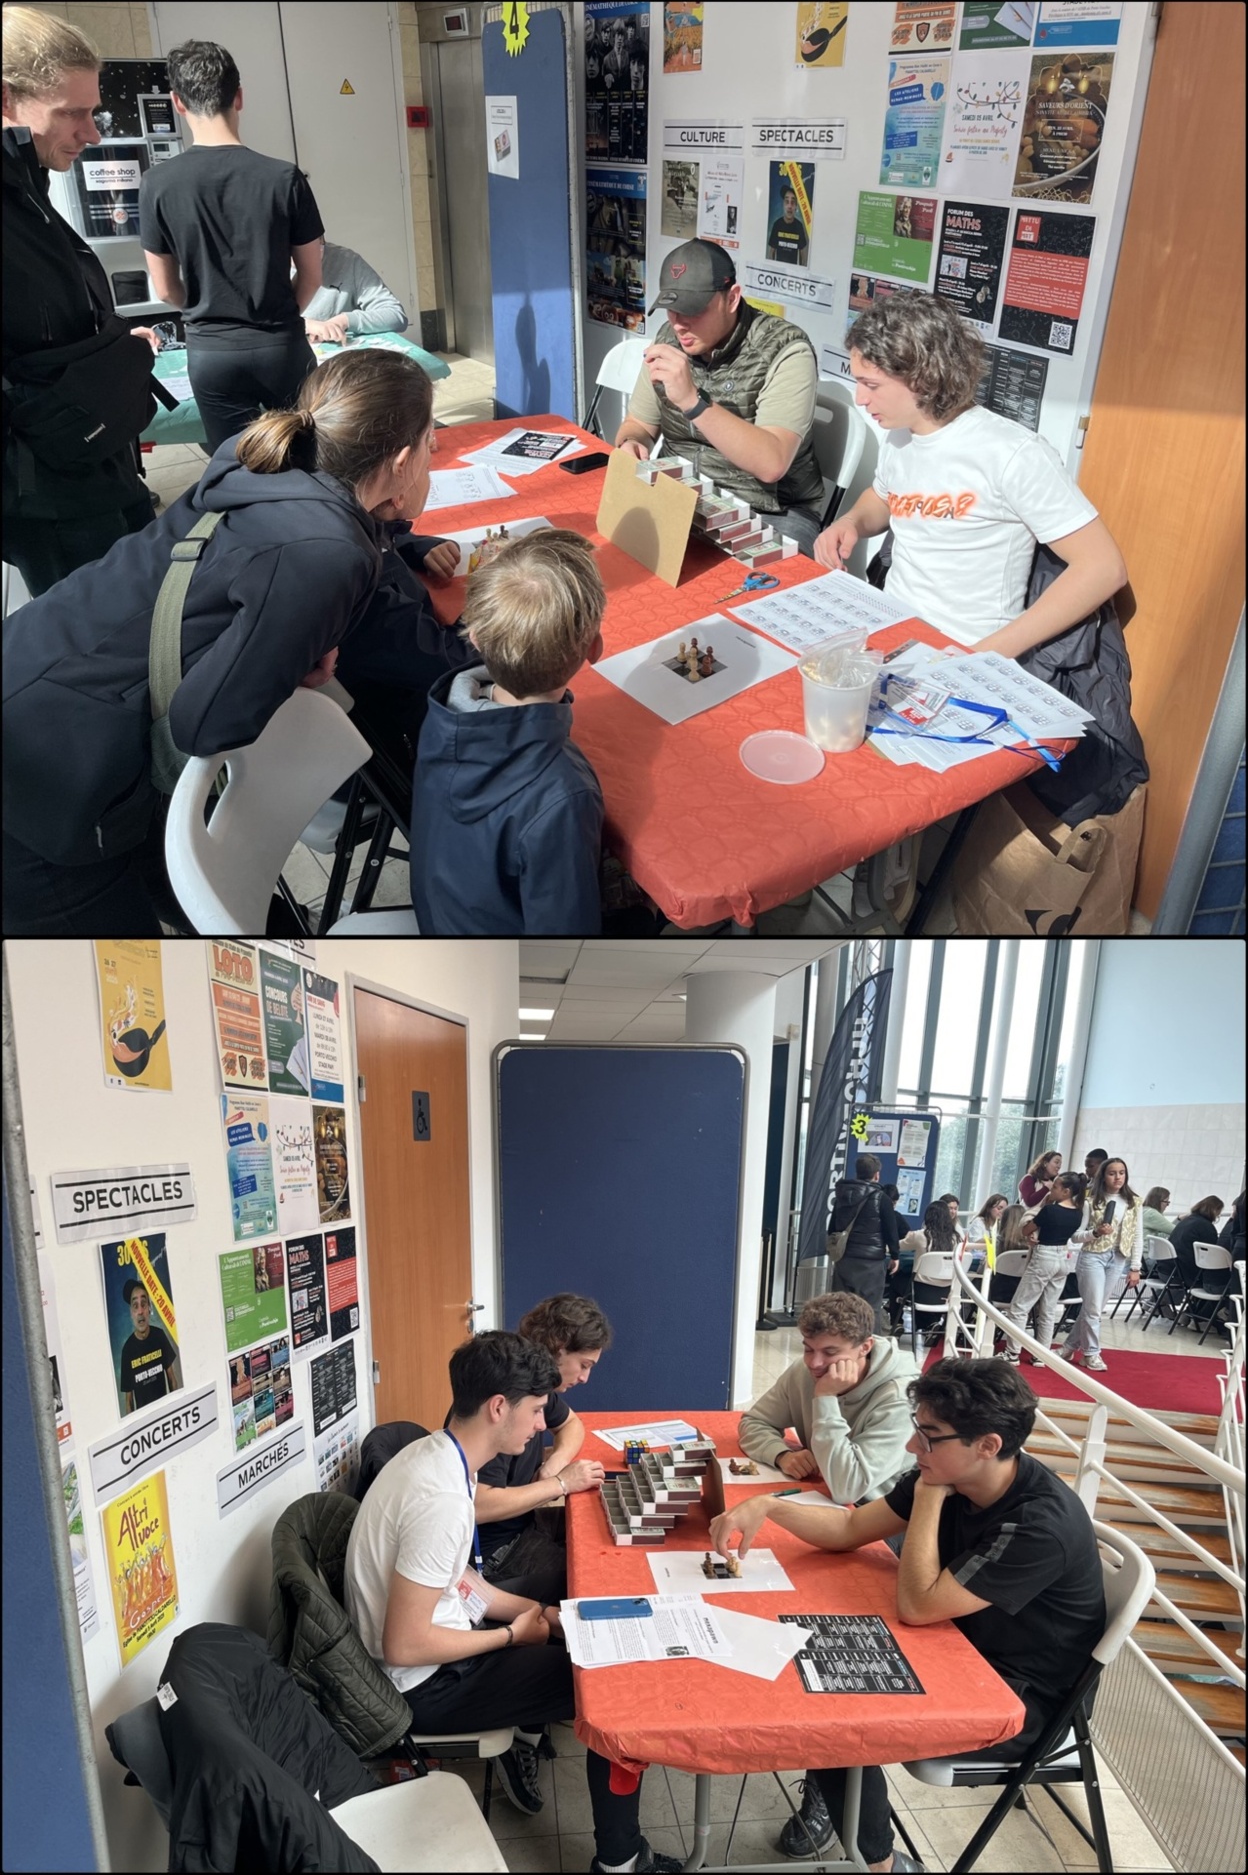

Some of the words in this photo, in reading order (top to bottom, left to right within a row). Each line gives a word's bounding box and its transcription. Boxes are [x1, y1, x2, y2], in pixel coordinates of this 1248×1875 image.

[680, 131, 725, 143] CULTURE
[759, 129, 834, 143] SPECTACLES
[89, 168, 116, 176] coffee
[116, 168, 135, 176] shop
[947, 208, 963, 216] FORUM
[945, 215, 982, 231] MATHS
[757, 274, 816, 297] CONCERTS
[212, 945, 253, 981] LOTO
[265, 985, 288, 1004] CONCOURS
[855, 1120, 866, 1135] 3
[72, 1180, 183, 1213] SPECTACLES
[130, 1240, 150, 1278] NOUVELLE
[289, 1250, 310, 1265] MATHS
[146, 1275, 158, 1296] DATE
[156, 1295, 165, 1308] 20
[160, 1305, 176, 1328] AVRIL
[131, 1358, 141, 1369] ERIC
[120, 1406, 201, 1466] CONCERTS
[238, 1441, 290, 1489] MARCHÉS
[117, 1497, 149, 1551] Altri
[137, 1517, 159, 1546] voce
[129, 1585, 167, 1629] Gospel
